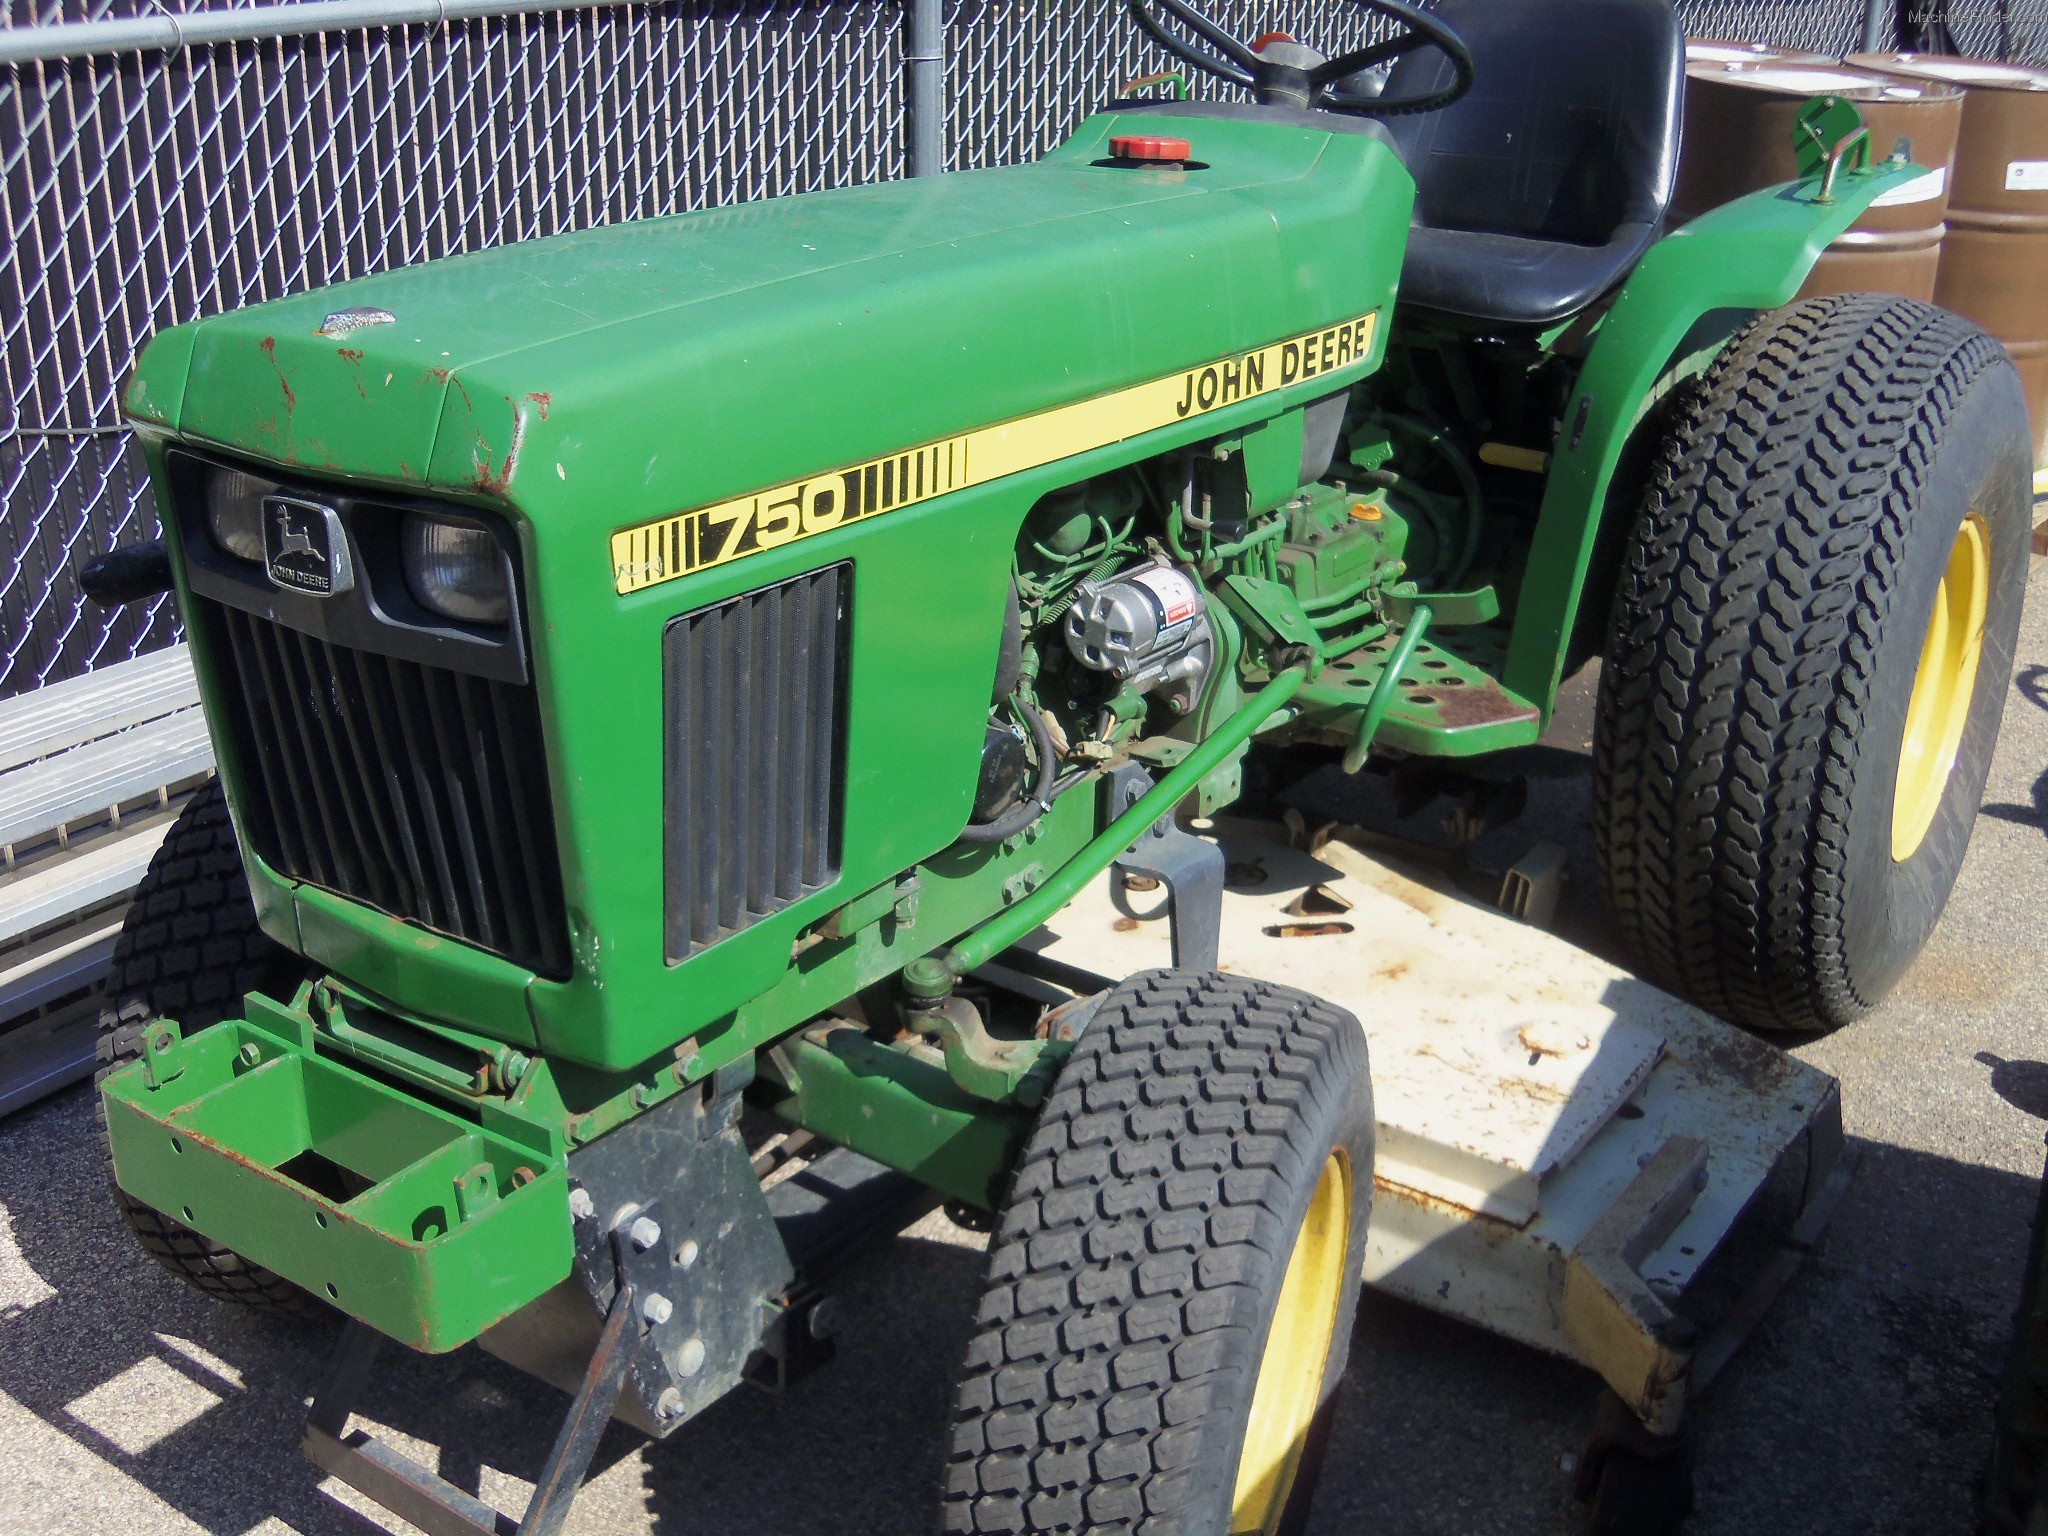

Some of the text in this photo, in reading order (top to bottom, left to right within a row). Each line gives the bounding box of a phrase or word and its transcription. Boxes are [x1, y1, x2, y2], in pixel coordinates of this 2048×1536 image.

[1176, 319, 1366, 417] JOHN DEERE
[708, 474, 846, 563] 750
[271, 564, 328, 588] JOHN DEERE
